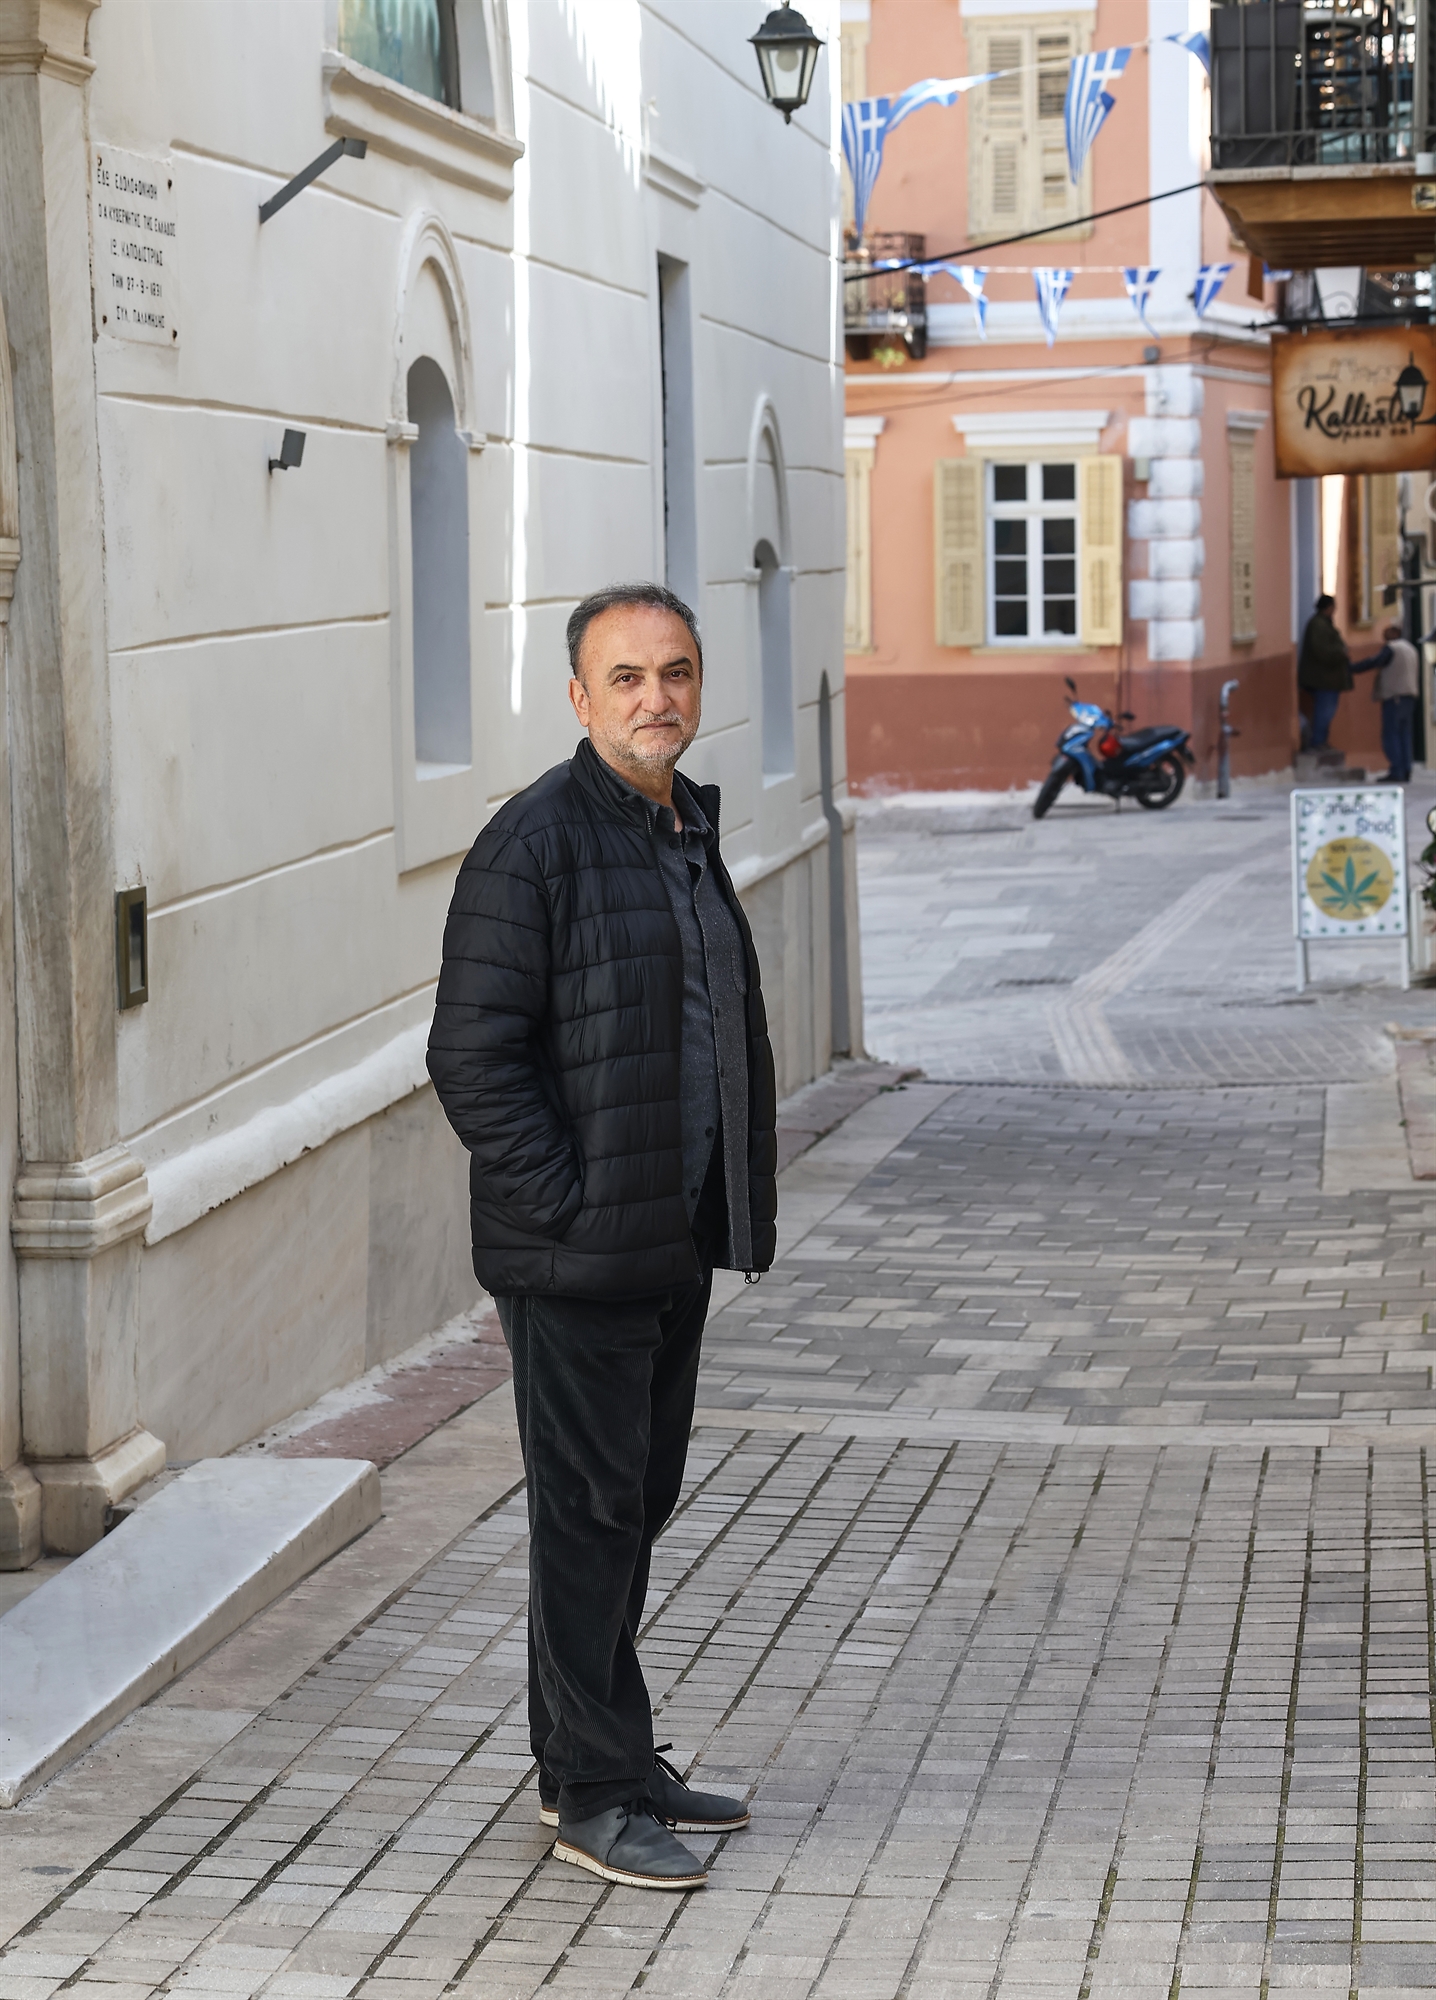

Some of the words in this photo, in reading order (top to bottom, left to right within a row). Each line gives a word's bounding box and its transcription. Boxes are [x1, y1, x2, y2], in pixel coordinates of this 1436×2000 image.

[143, 214, 153, 231] ΤΗΣ
[111, 273, 123, 289] ΤΗΝ
[1302, 799, 1377, 816] Cnnabis
